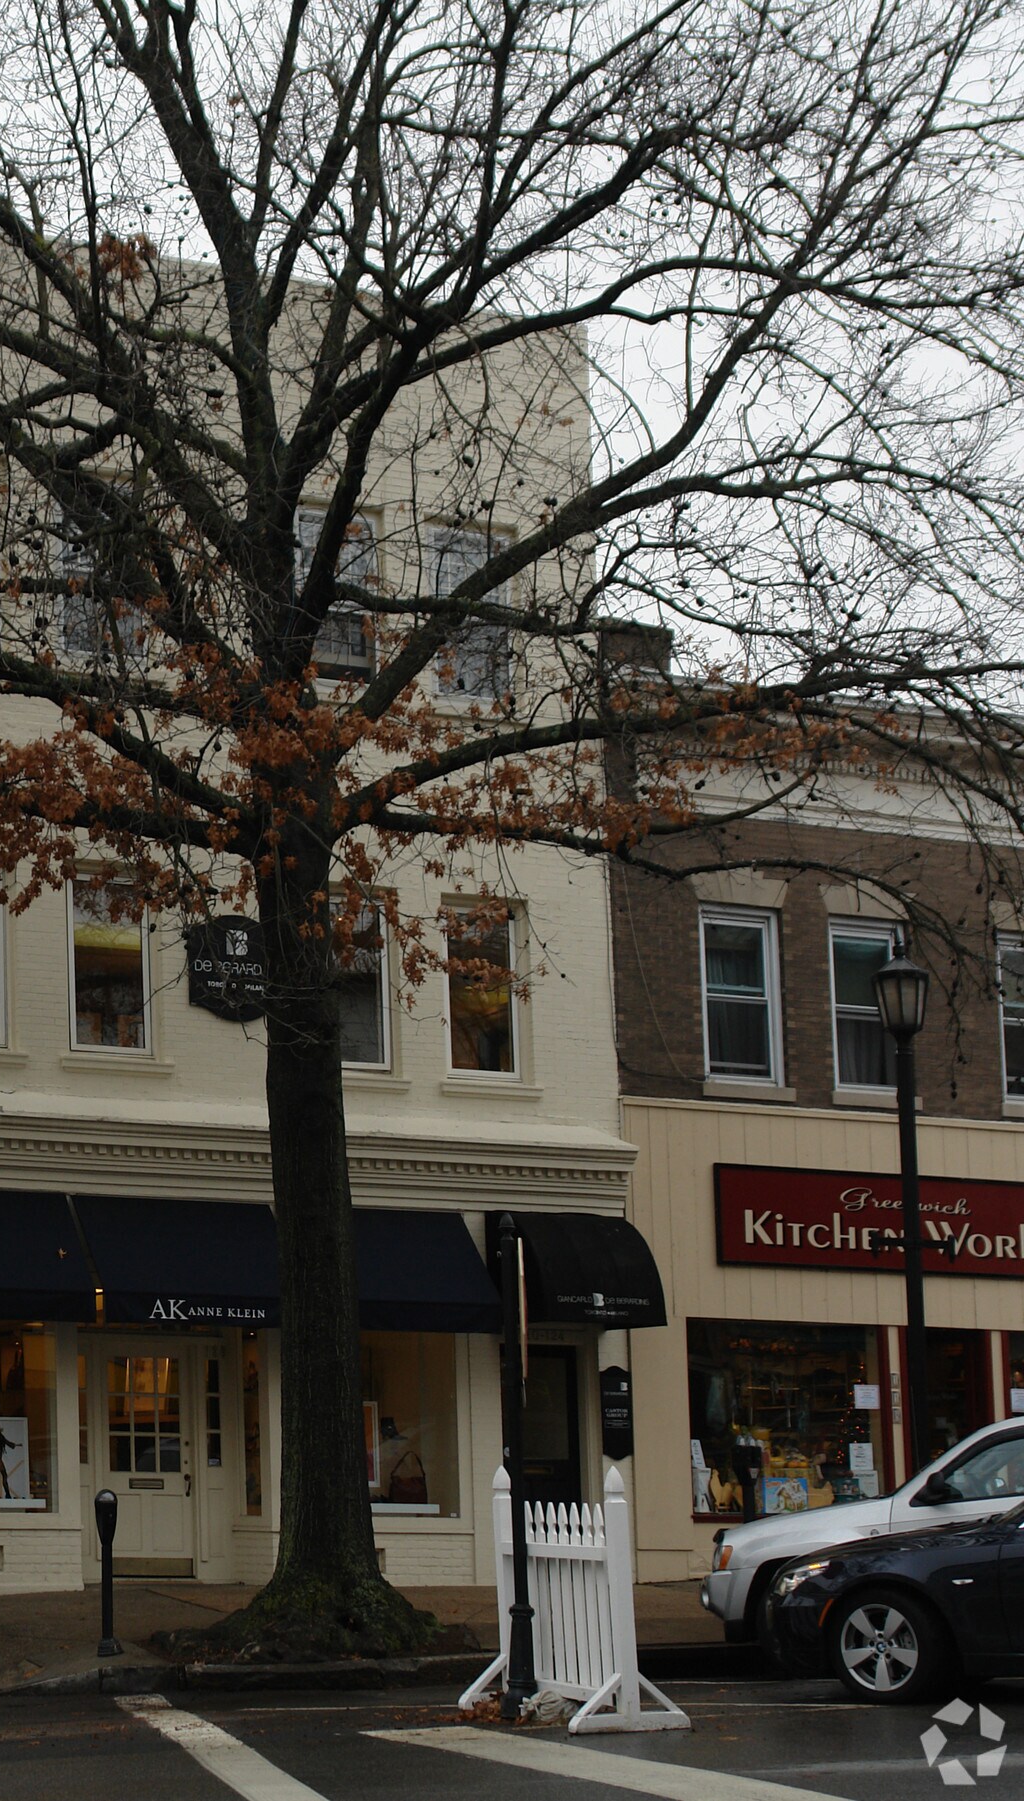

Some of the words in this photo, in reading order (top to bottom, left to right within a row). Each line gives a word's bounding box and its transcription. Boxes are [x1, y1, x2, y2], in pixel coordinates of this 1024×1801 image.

[839, 1186, 971, 1215] Greewich
[924, 1220, 1024, 1260] WOR
[148, 1298, 189, 1320] AK
[188, 1306, 223, 1317] ANNE
[227, 1307, 266, 1319] KLEIN
